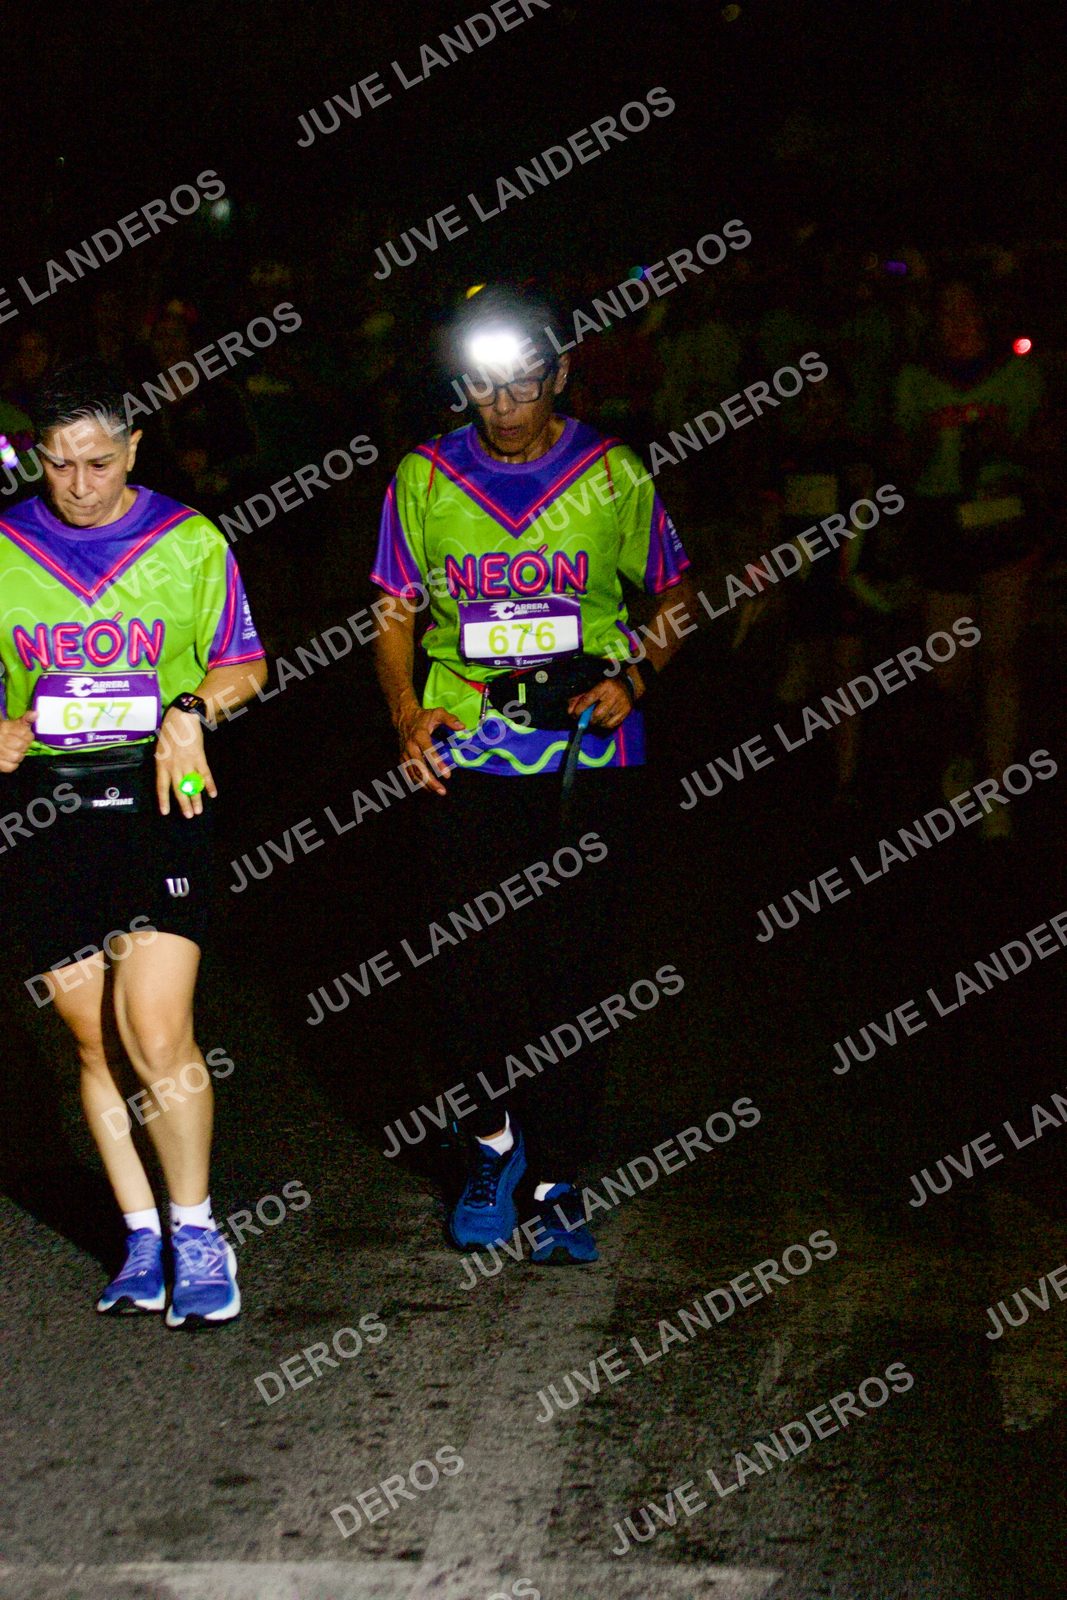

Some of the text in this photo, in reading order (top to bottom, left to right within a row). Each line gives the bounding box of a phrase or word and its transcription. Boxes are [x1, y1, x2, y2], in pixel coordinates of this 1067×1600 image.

[445, 544, 588, 600] NEÓN
[13, 611, 165, 671] NEÓN
[488, 620, 556, 655] 676
[63, 702, 133, 731] 677
